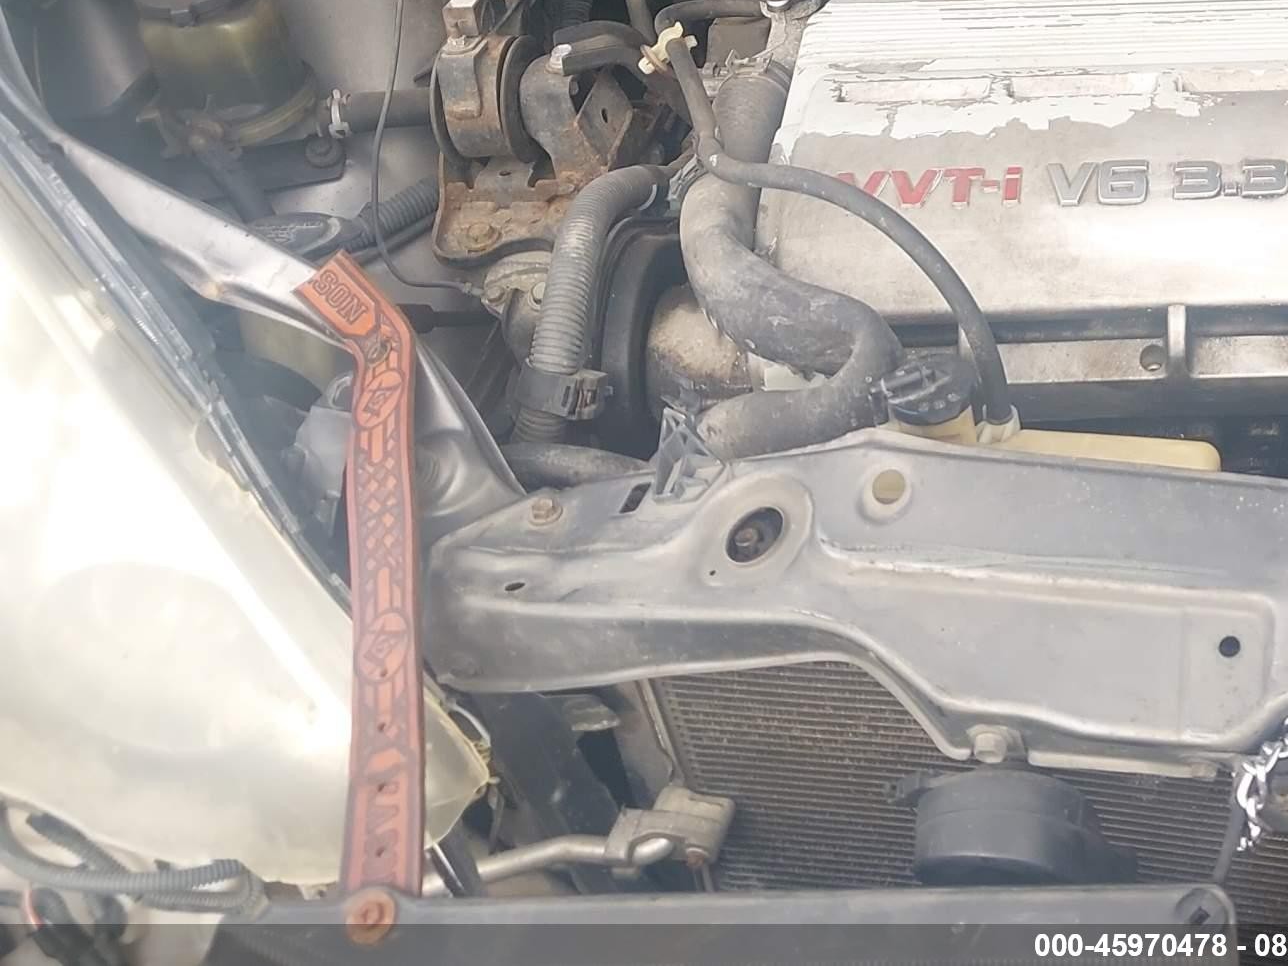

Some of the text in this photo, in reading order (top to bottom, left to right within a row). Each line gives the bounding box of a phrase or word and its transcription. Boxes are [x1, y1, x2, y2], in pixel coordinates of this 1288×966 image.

[836, 166, 1024, 209] VVT-i
[1046, 159, 1149, 208] V6
[309, 268, 369, 326] SON
